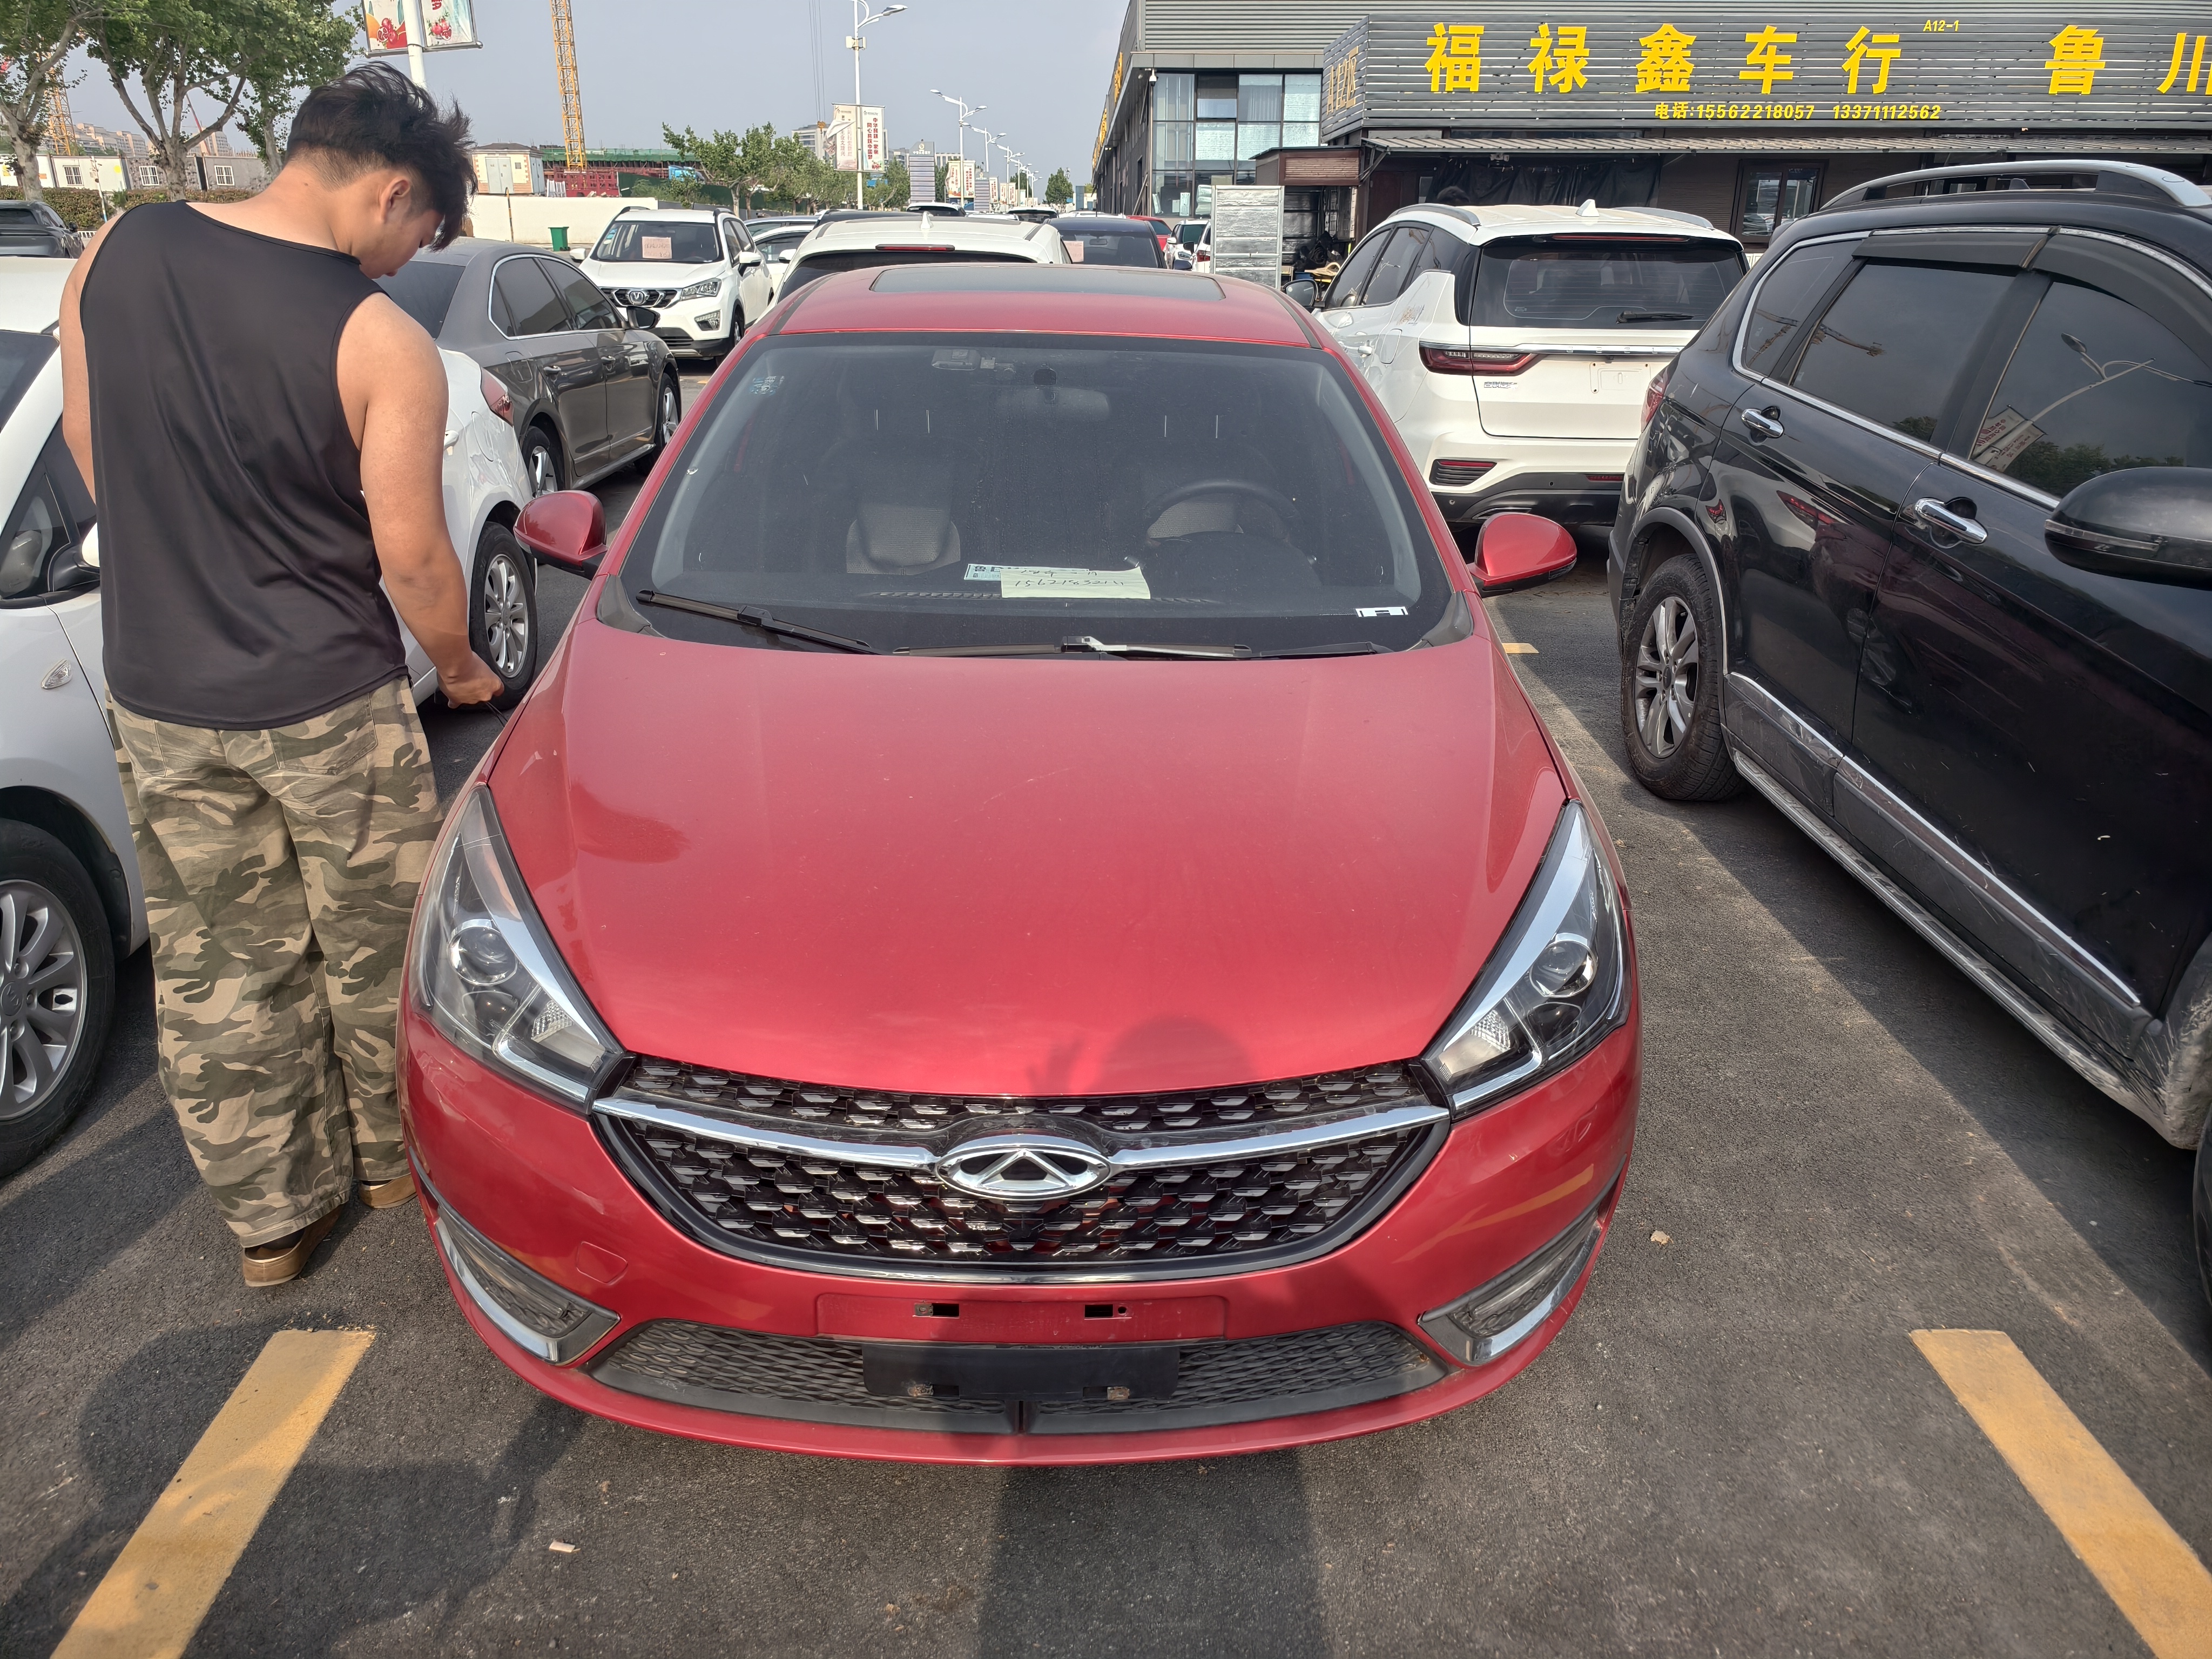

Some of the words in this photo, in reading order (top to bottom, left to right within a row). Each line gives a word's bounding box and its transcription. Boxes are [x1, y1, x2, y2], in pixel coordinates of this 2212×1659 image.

[1923, 20, 1959, 31] A12-1
[1425, 23, 1901, 95] 福禄鑫车行
[1833, 105, 1941, 119] 13371112562
